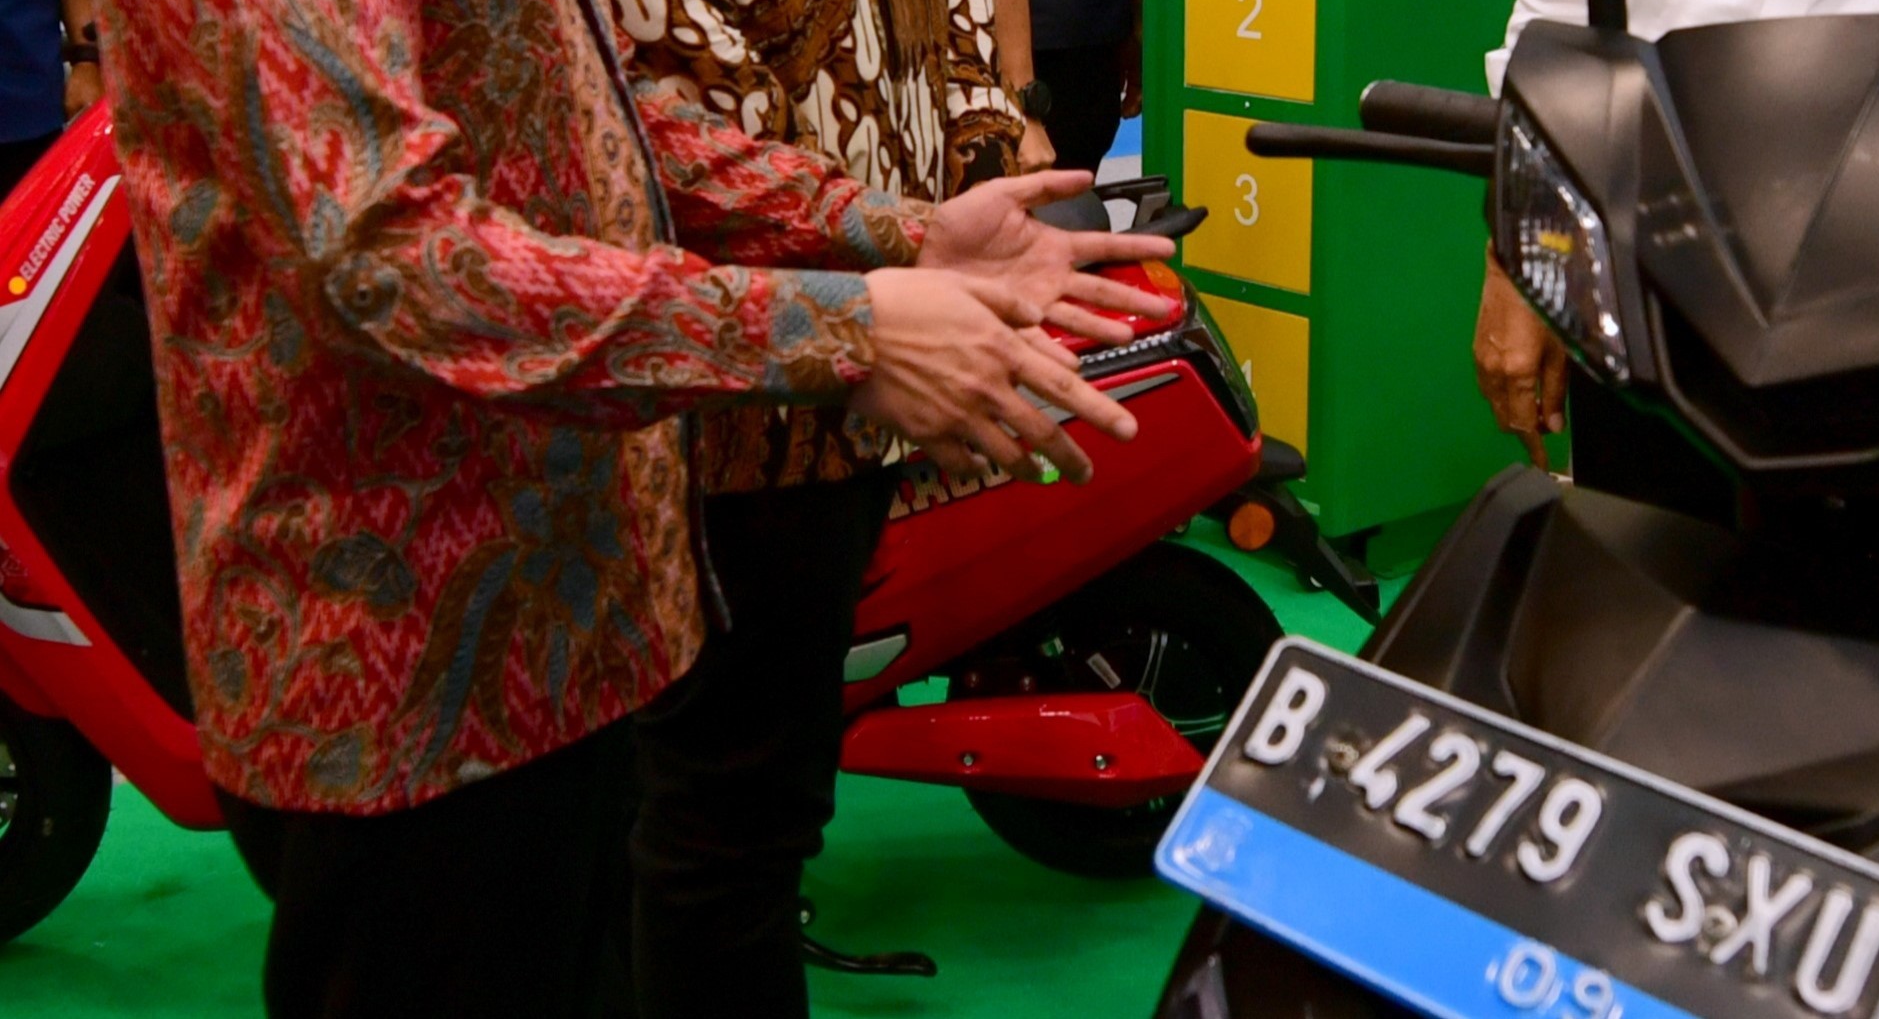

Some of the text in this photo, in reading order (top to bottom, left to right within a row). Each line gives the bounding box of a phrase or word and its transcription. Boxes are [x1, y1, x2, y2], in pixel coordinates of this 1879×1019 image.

[19, 173, 96, 282] ELECTRIC POWER
[1234, 173, 1260, 226] 3
[1245, 667, 1327, 765] B
[1350, 713, 1603, 882] 4279
